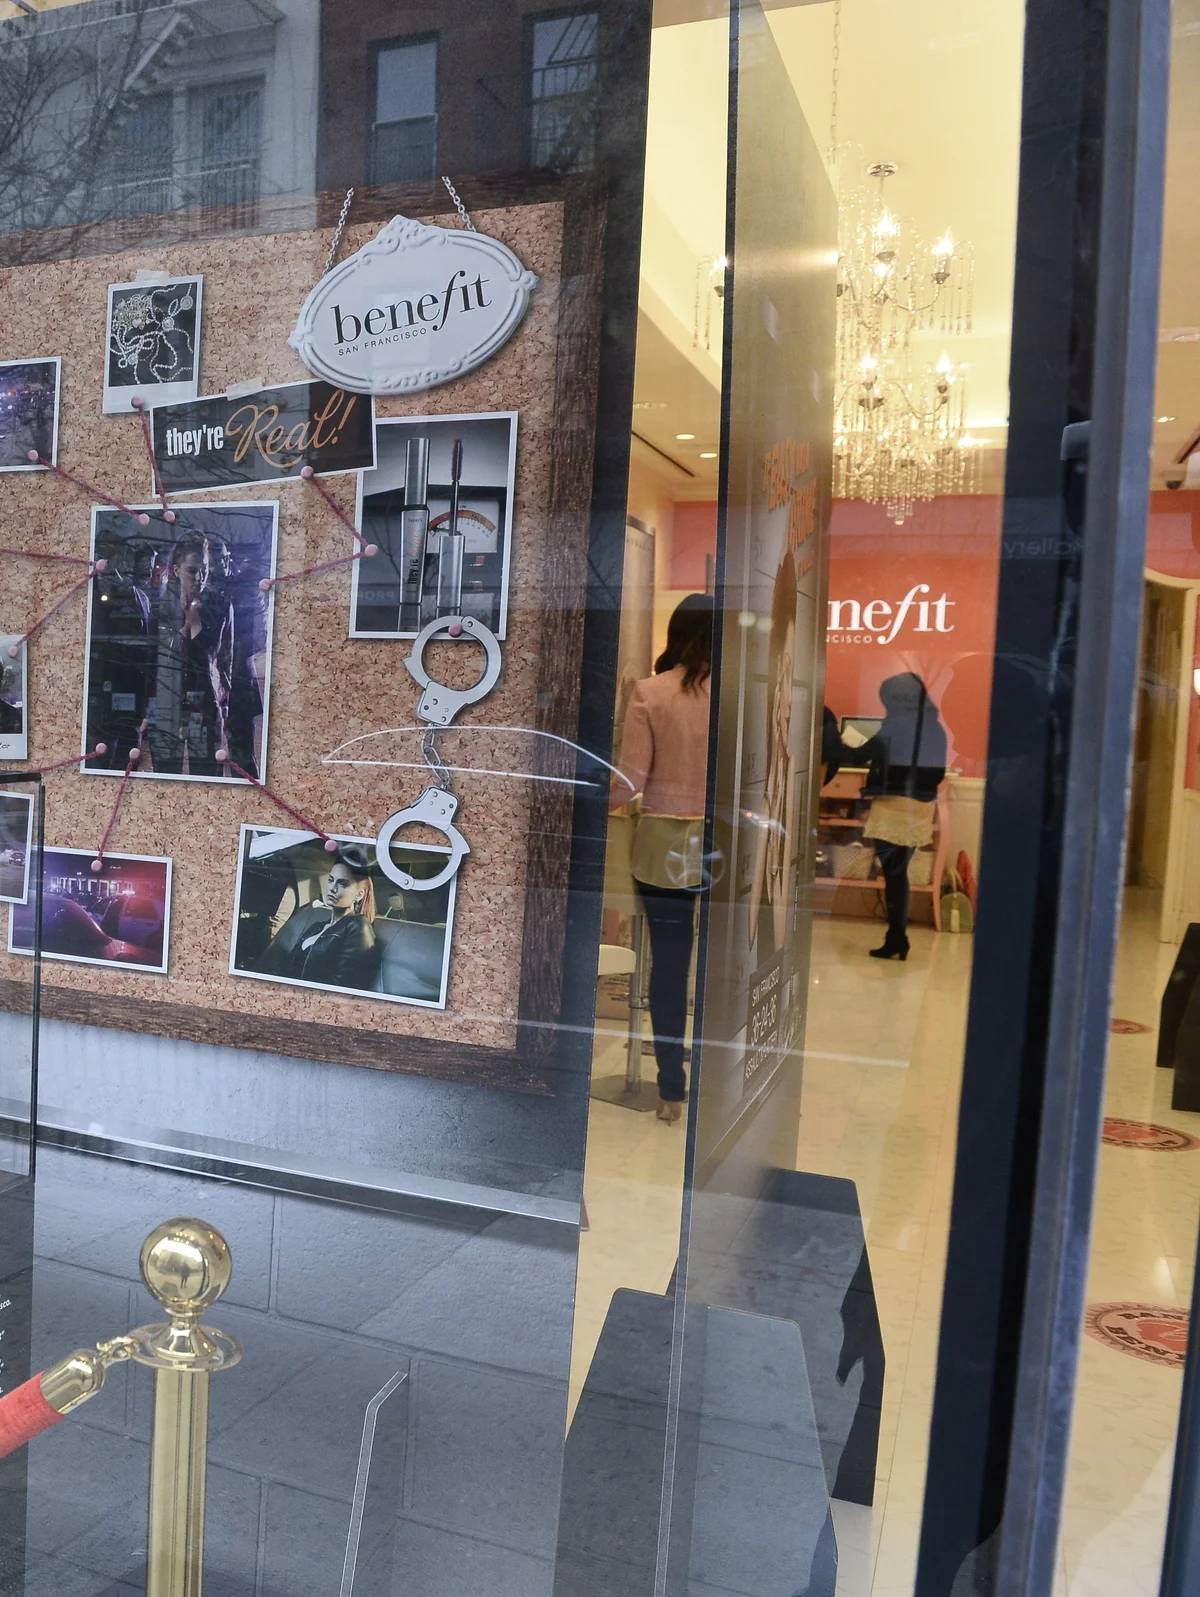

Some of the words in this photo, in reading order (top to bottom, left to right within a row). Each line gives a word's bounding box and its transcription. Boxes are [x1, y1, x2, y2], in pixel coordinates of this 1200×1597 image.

[330, 270, 493, 346] benefit
[338, 345, 359, 356] SAN
[364, 328, 428, 350] FRANCISCO
[166, 424, 224, 457] they're
[225, 389, 357, 469] Real!
[826, 634, 873, 645] CISCO
